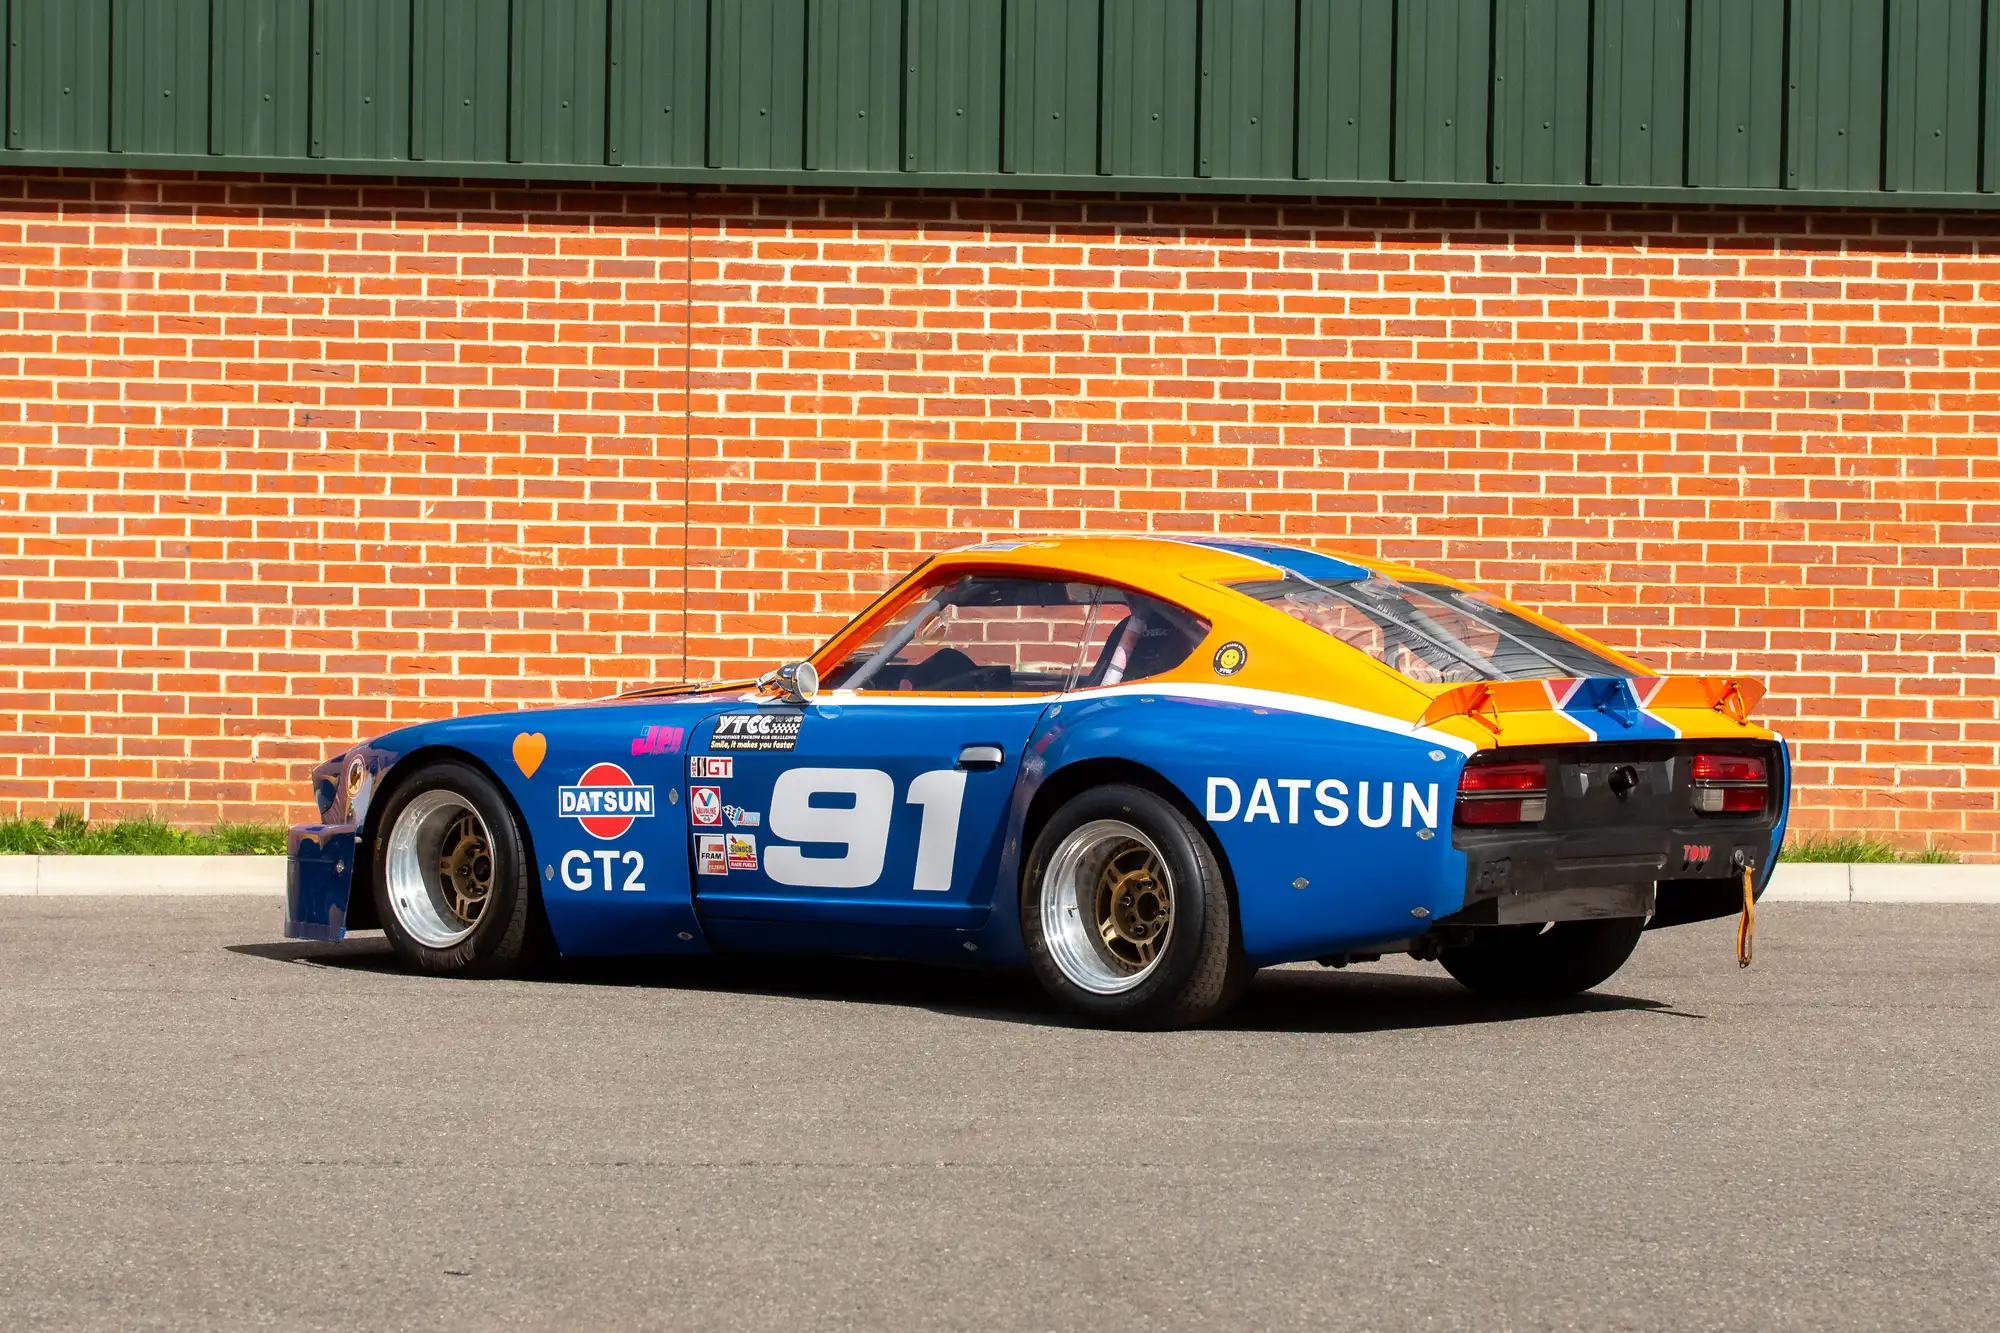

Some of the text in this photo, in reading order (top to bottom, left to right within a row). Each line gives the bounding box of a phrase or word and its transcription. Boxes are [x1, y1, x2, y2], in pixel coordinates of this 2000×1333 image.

[715, 714, 774, 734] YTCC
[710, 740, 794, 750] Smile, it makes you faster
[708, 759, 731, 775] GT
[562, 791, 650, 812] DATSUN
[1206, 776, 1439, 829] DATSUN
[764, 767, 967, 891] 91
[1683, 845, 1711, 861] TOW
[560, 849, 646, 891] GT2
